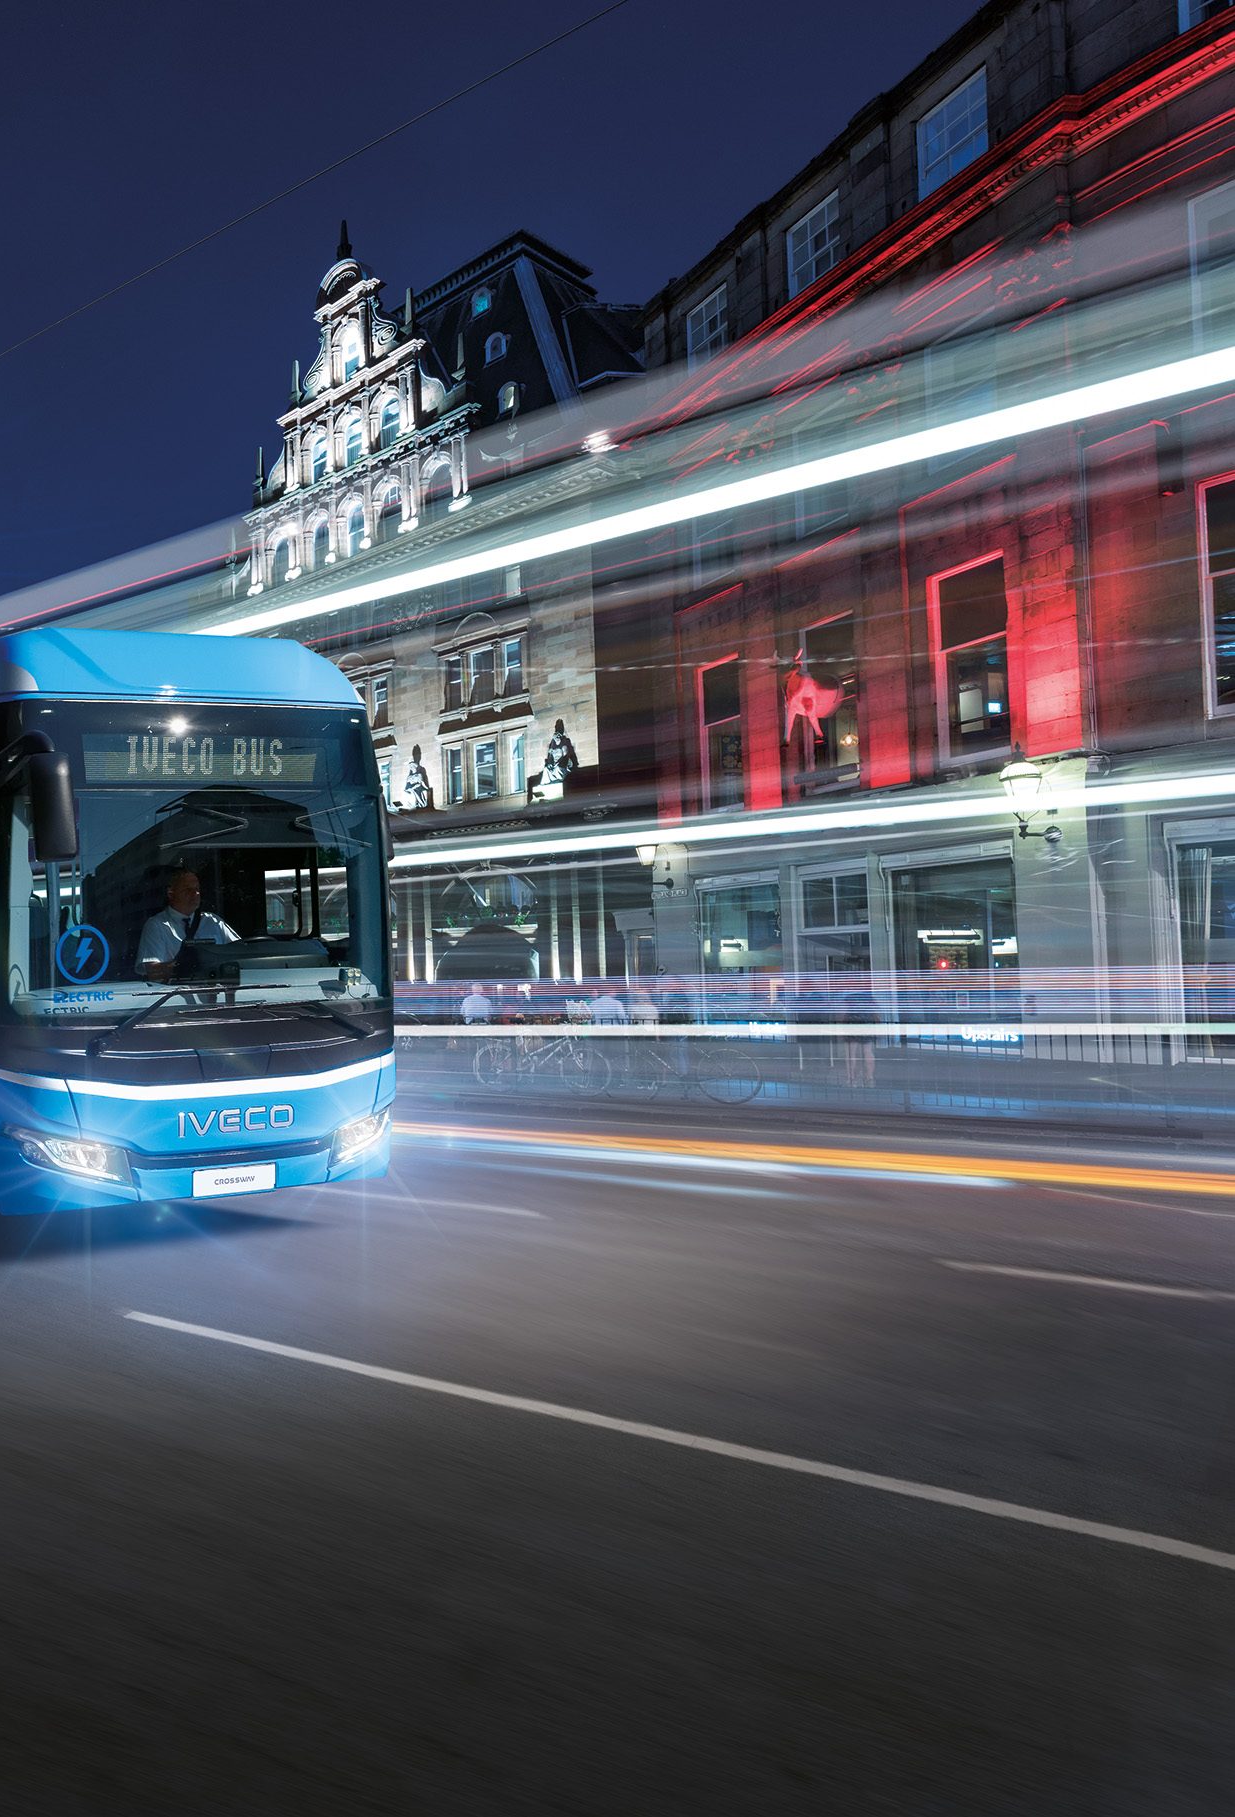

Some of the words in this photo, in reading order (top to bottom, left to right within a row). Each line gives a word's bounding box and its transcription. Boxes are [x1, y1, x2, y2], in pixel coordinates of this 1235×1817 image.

[126, 735, 214, 775] IVECO
[233, 738, 283, 776] BUS
[53, 990, 114, 1003] ELECTRIC
[961, 1026, 1019, 1042] Upstairs
[178, 1104, 294, 1138] IVECO
[214, 1175, 255, 1185] CROSSWAY
